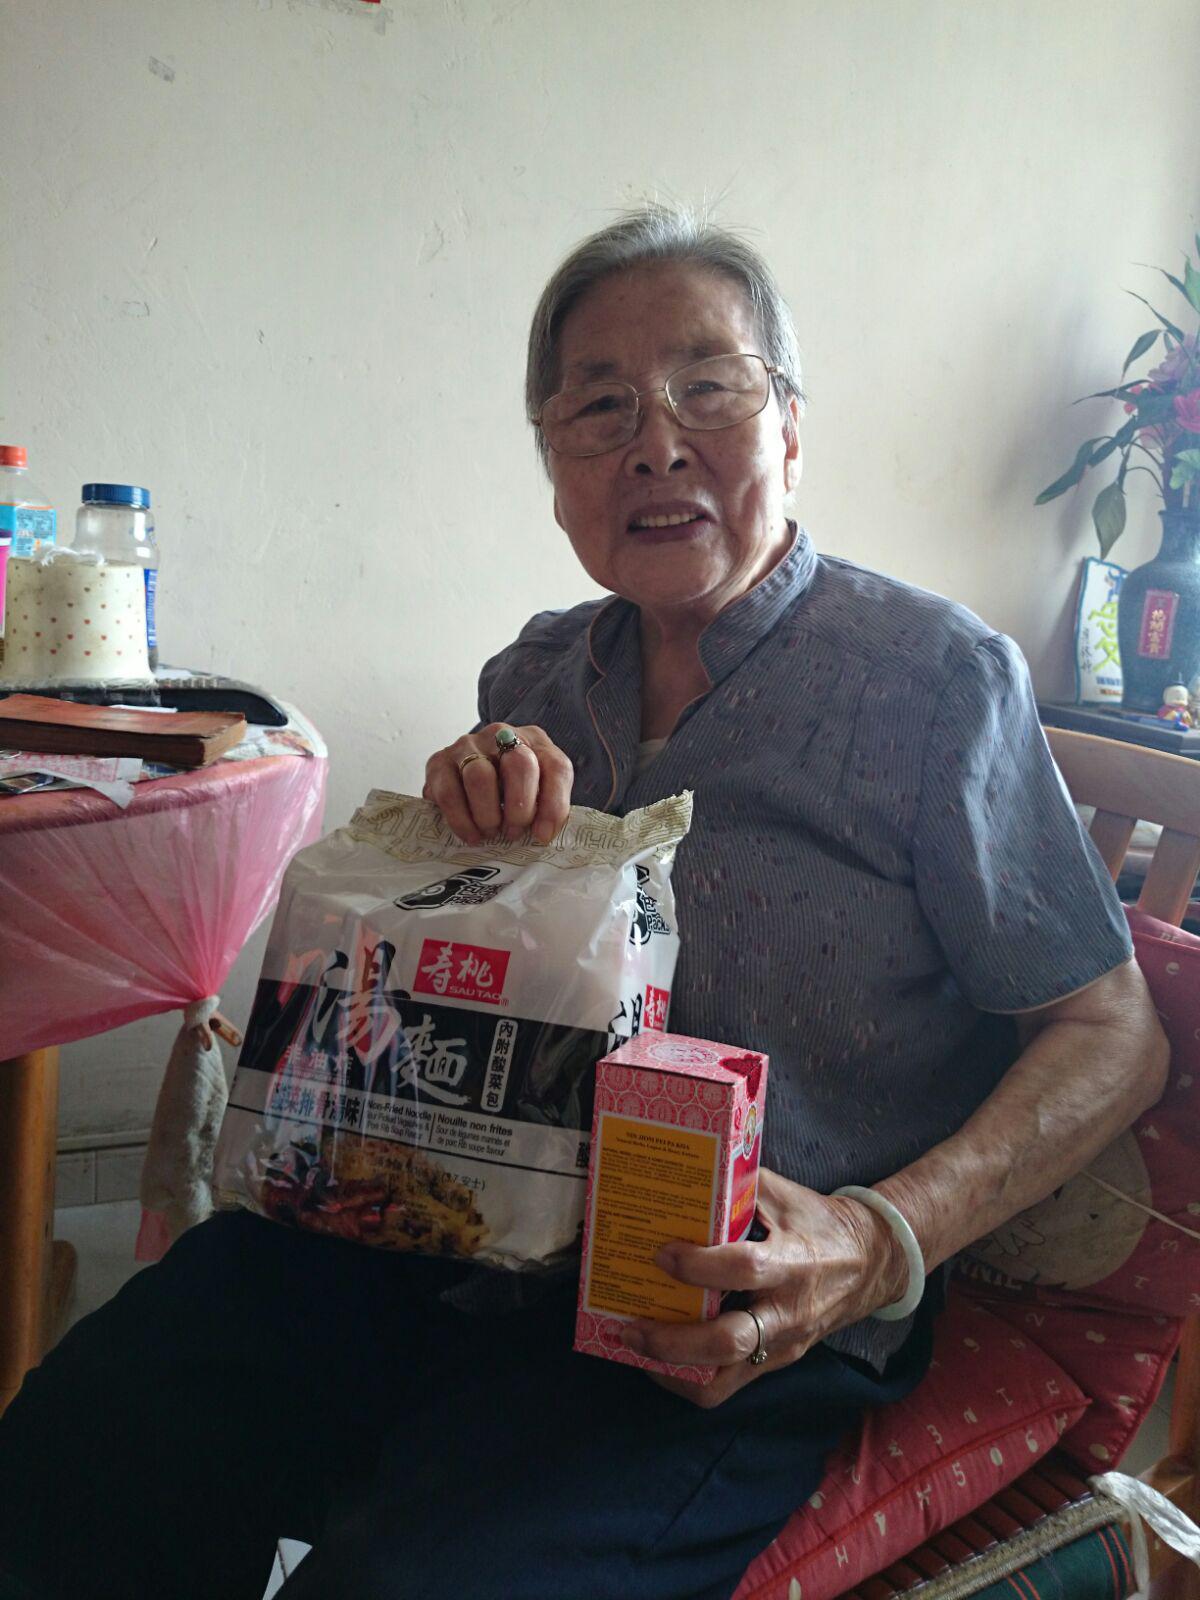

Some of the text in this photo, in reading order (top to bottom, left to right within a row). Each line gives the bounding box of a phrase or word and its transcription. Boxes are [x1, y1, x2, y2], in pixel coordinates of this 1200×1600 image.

[448, 985, 476, 998] SAU
[437, 1113, 513, 1136] Nouille non frites
